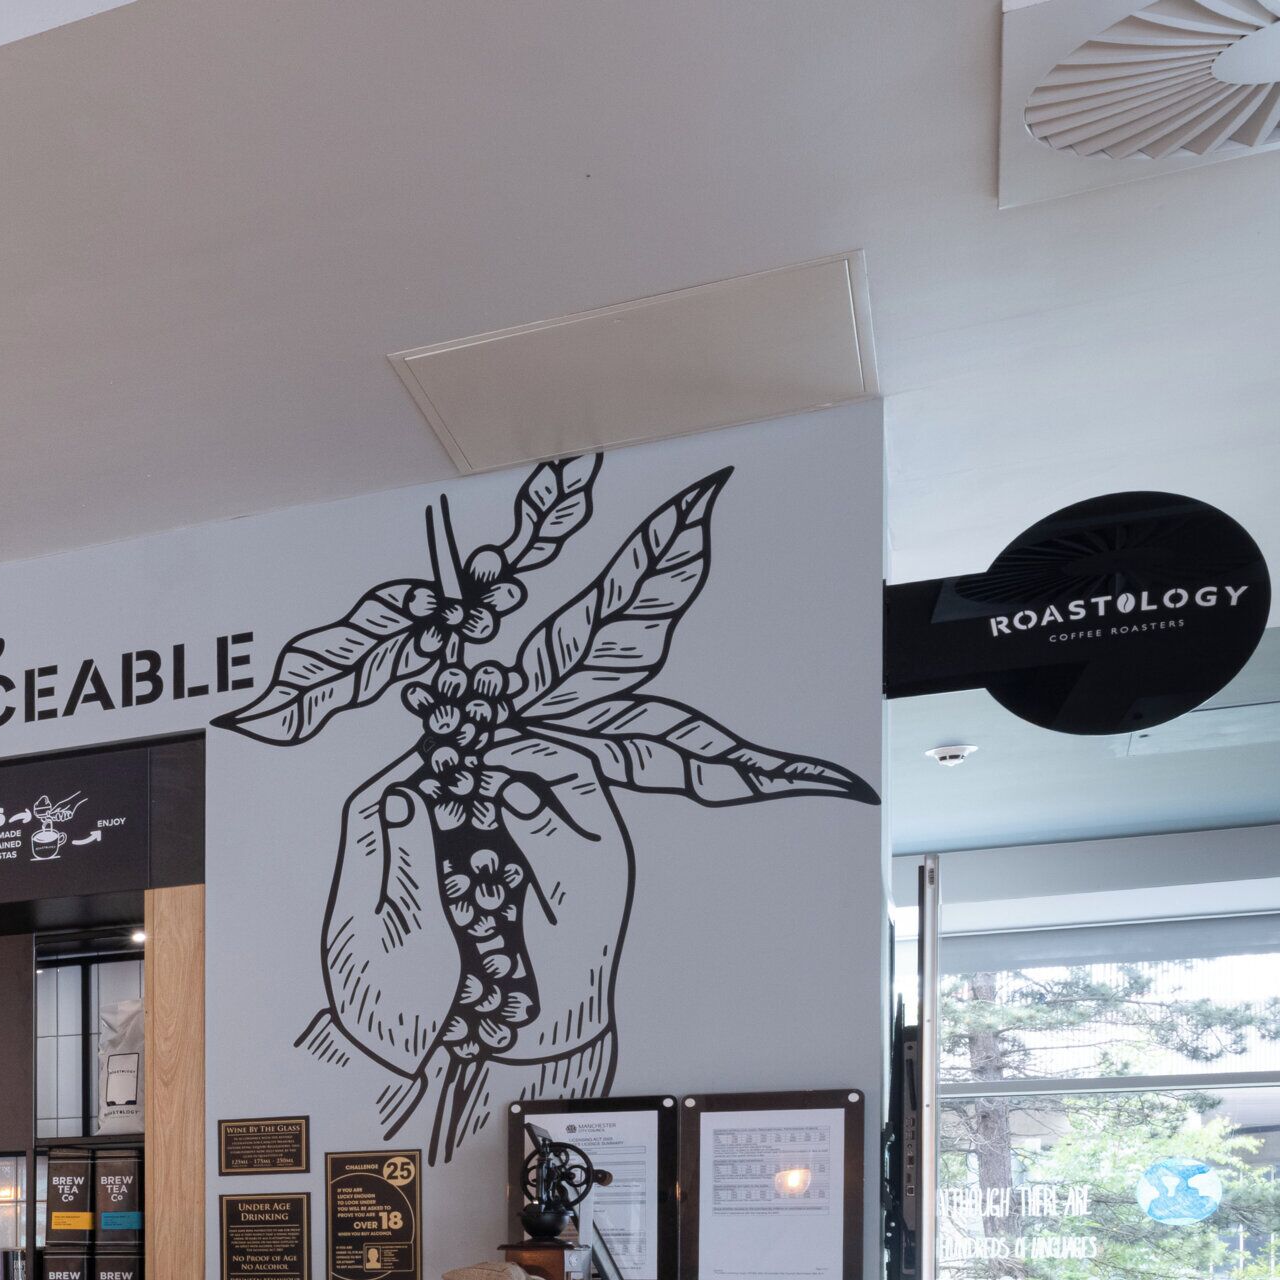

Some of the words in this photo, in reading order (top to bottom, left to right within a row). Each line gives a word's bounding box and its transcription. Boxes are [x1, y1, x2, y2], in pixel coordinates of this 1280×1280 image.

[990, 585, 1249, 637] ROASTOLOGY
[1049, 629, 1102, 643] COFFEE
[1111, 619, 1185, 635] ROASTERS
[97, 817, 126, 828] ENJOY
[386, 1161, 412, 1180] 25
[53, 1177, 84, 1185] BREW
[101, 1176, 133, 1184] BREW
[106, 1185, 128, 1193] TEA
[62, 1194, 74, 1202] Co
[111, 1194, 123, 1202] Co
[354, 1221, 378, 1229] OVER
[379, 1211, 403, 1229] 18
[49, 1272, 81, 1280] BREW
[100, 1272, 133, 1280] BREW
